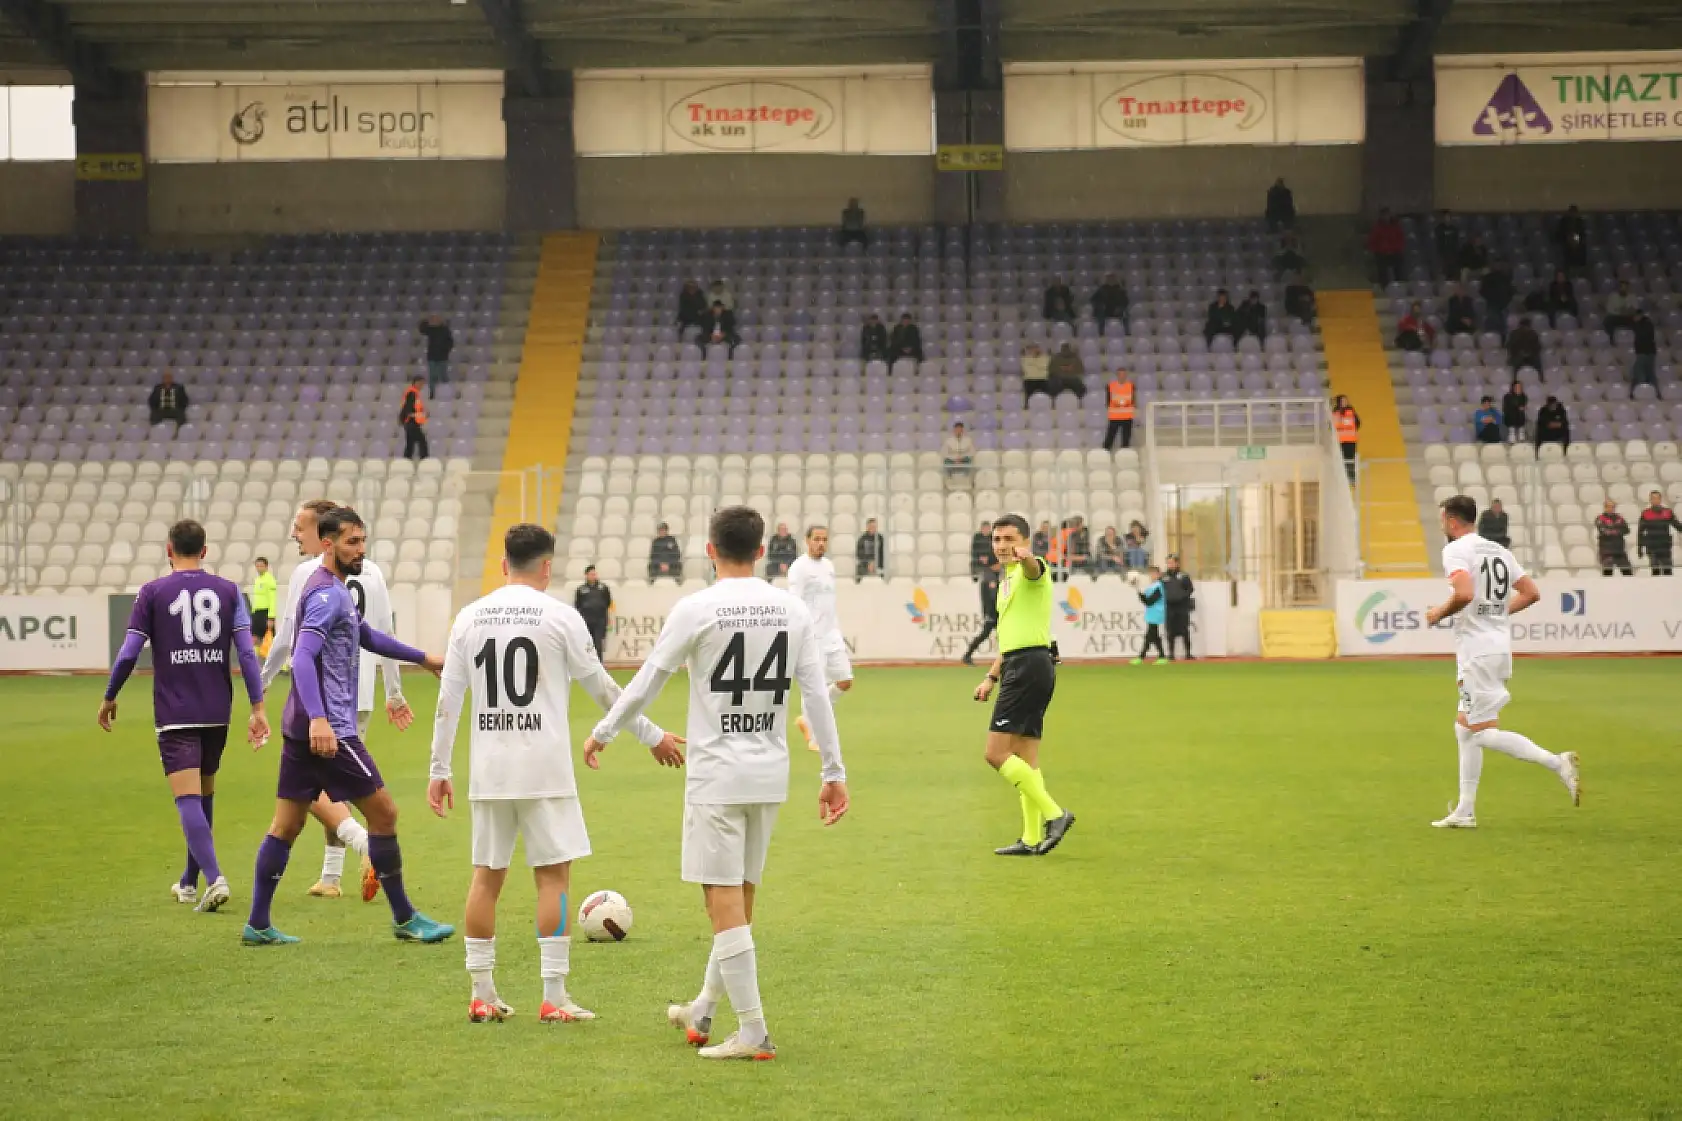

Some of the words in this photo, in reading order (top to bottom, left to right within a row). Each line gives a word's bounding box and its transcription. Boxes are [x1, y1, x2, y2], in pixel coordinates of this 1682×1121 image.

[1552, 73, 1682, 103] TINAZT
[687, 103, 815, 126] Tınaztepe
[1118, 97, 1245, 117] Tınaztepe
[358, 111, 434, 148] spor
[720, 125, 746, 136] un
[1561, 109, 1668, 133] ŞİRKETLER
[1480, 556, 1509, 600] 19
[168, 588, 221, 645] 18
[1373, 611, 1420, 630] HES
[1511, 622, 1636, 641] DERMAVIA
[474, 637, 539, 708] 10
[711, 631, 791, 706] 44
[479, 709, 514, 731] BEKİR
[518, 714, 541, 731] CAN
[721, 712, 775, 732] ERDEM
